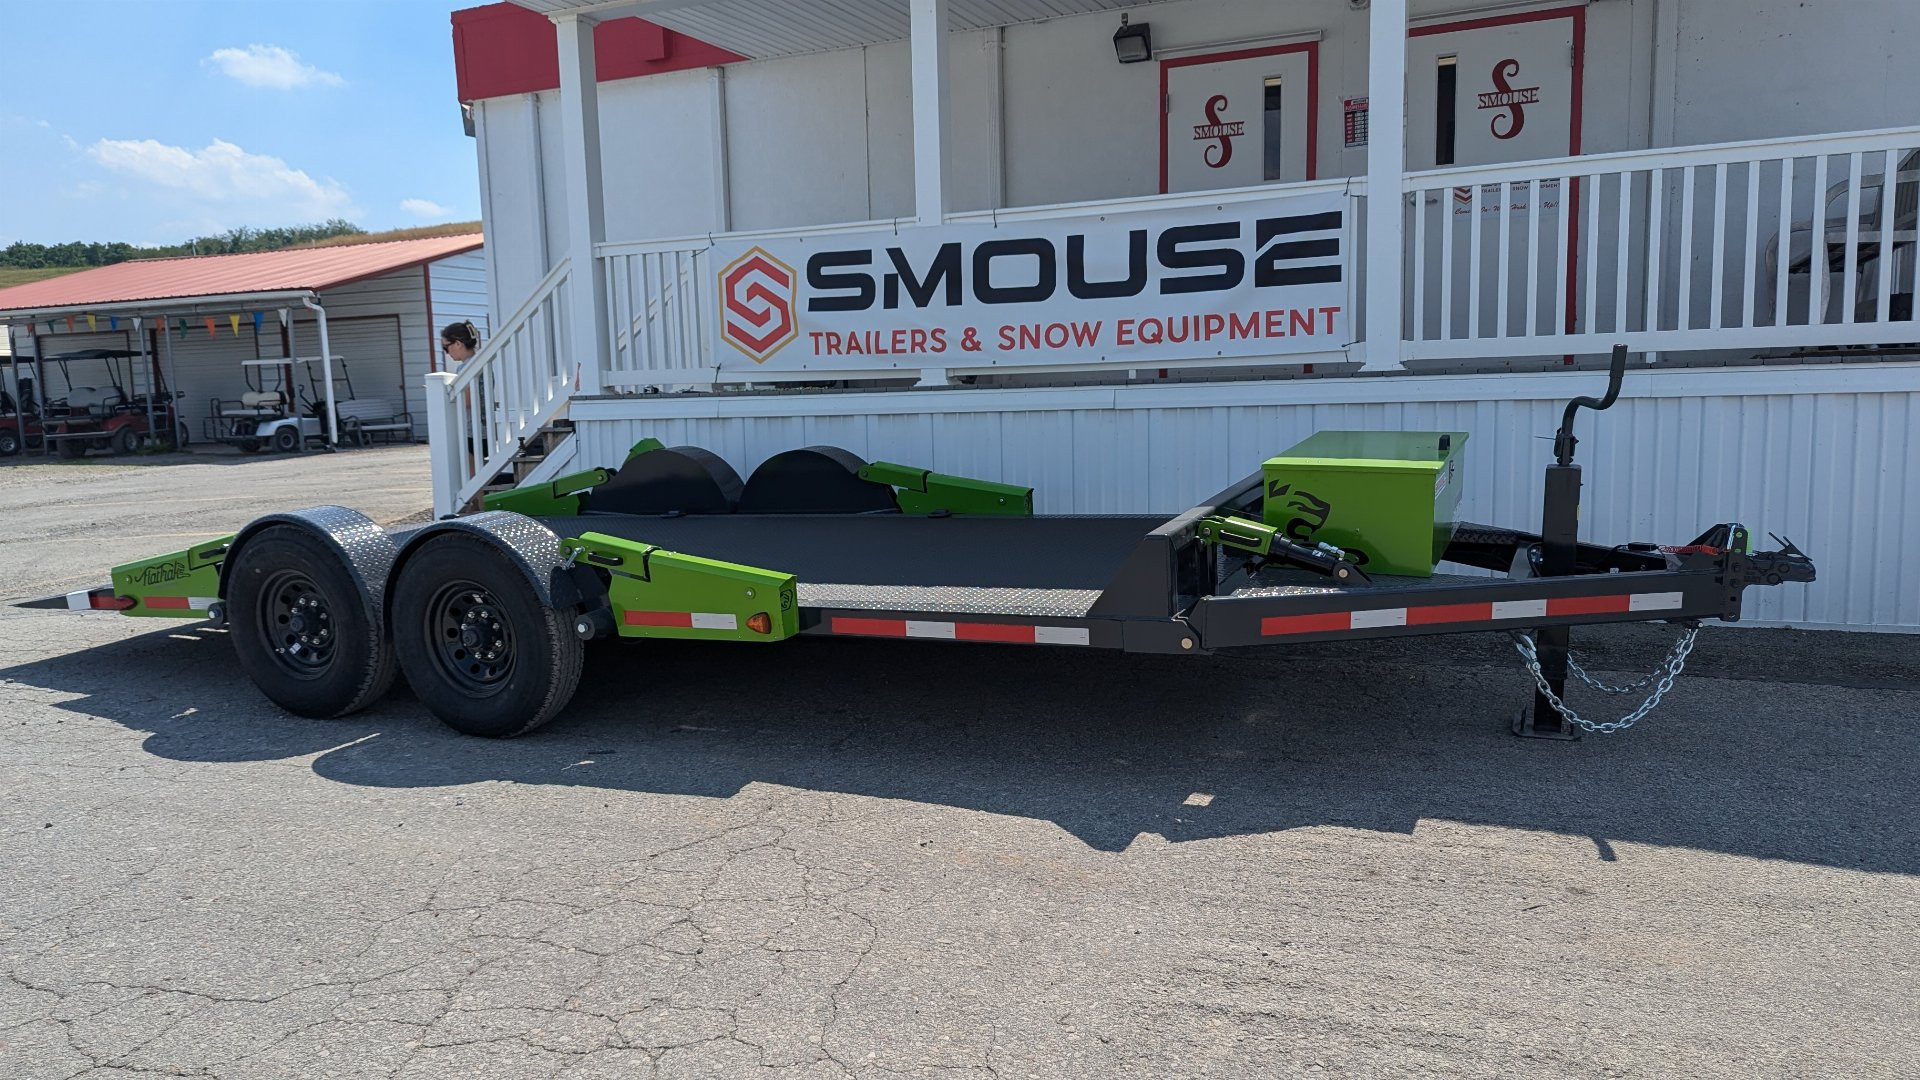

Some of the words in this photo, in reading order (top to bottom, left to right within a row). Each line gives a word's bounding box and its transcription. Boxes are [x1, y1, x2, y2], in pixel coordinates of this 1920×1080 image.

[1478, 88, 1539, 108] SMOUSE
[1193, 122, 1245, 140] SMOUSE
[806, 211, 1343, 312] SMOUSE
[809, 327, 948, 356] TRAILERS
[960, 326, 983, 352] &
[997, 319, 1103, 351] SNOW
[1116, 306, 1342, 346] EQUIPMENT
